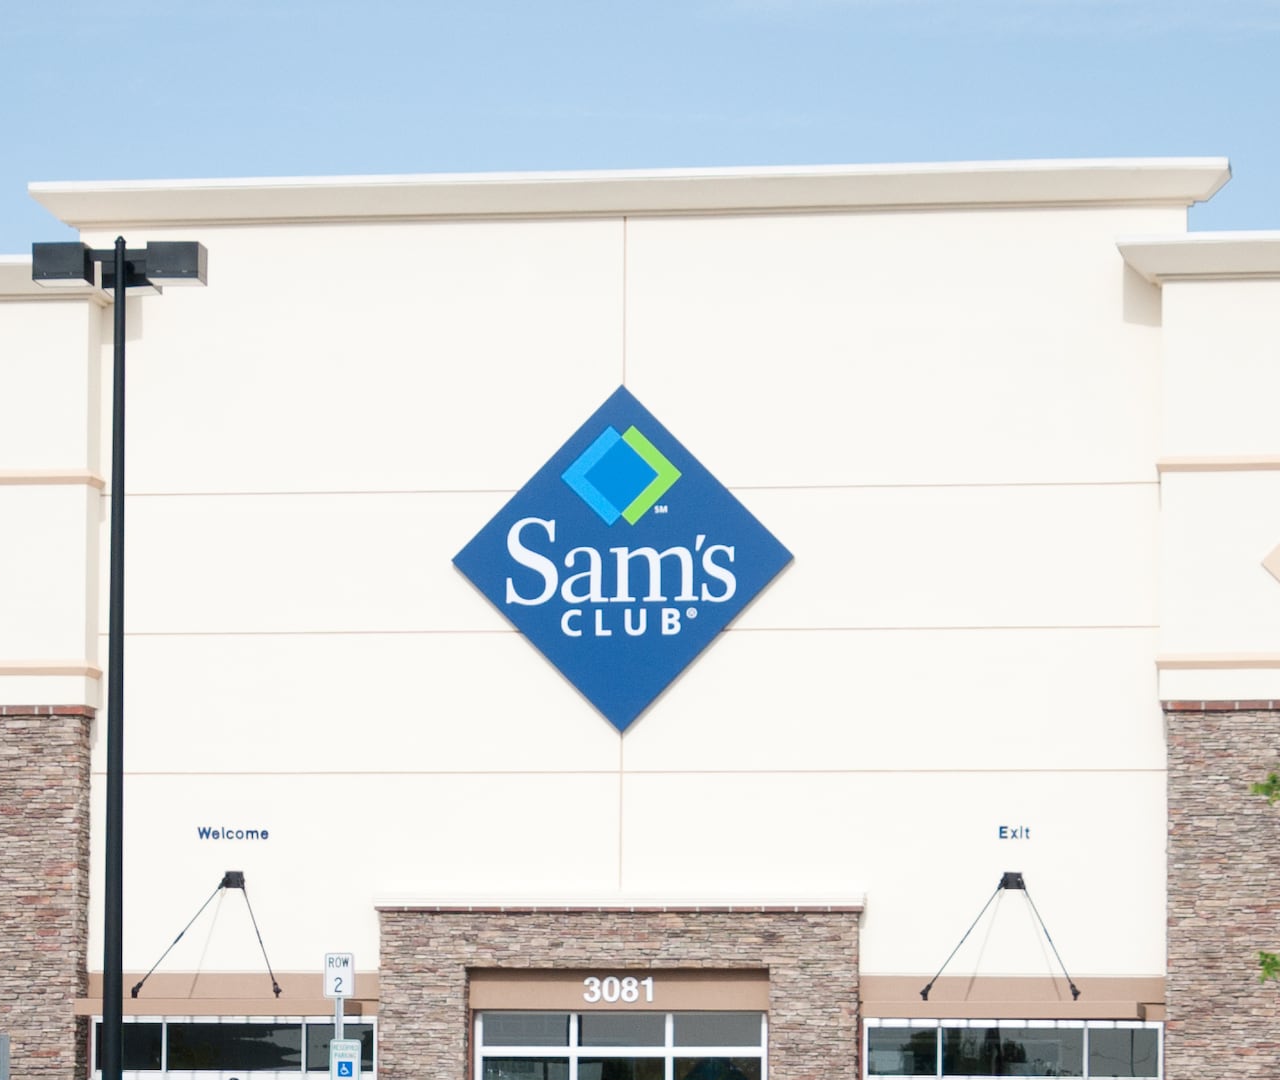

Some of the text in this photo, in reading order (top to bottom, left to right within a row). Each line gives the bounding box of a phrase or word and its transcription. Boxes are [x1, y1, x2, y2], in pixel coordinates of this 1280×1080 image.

[505, 516, 737, 606] Sam's
[197, 826, 270, 840] Welcome
[999, 825, 1030, 840] Exit
[328, 957, 349, 968] ROW
[334, 976, 344, 993] 2
[583, 976, 655, 1003] 3081
